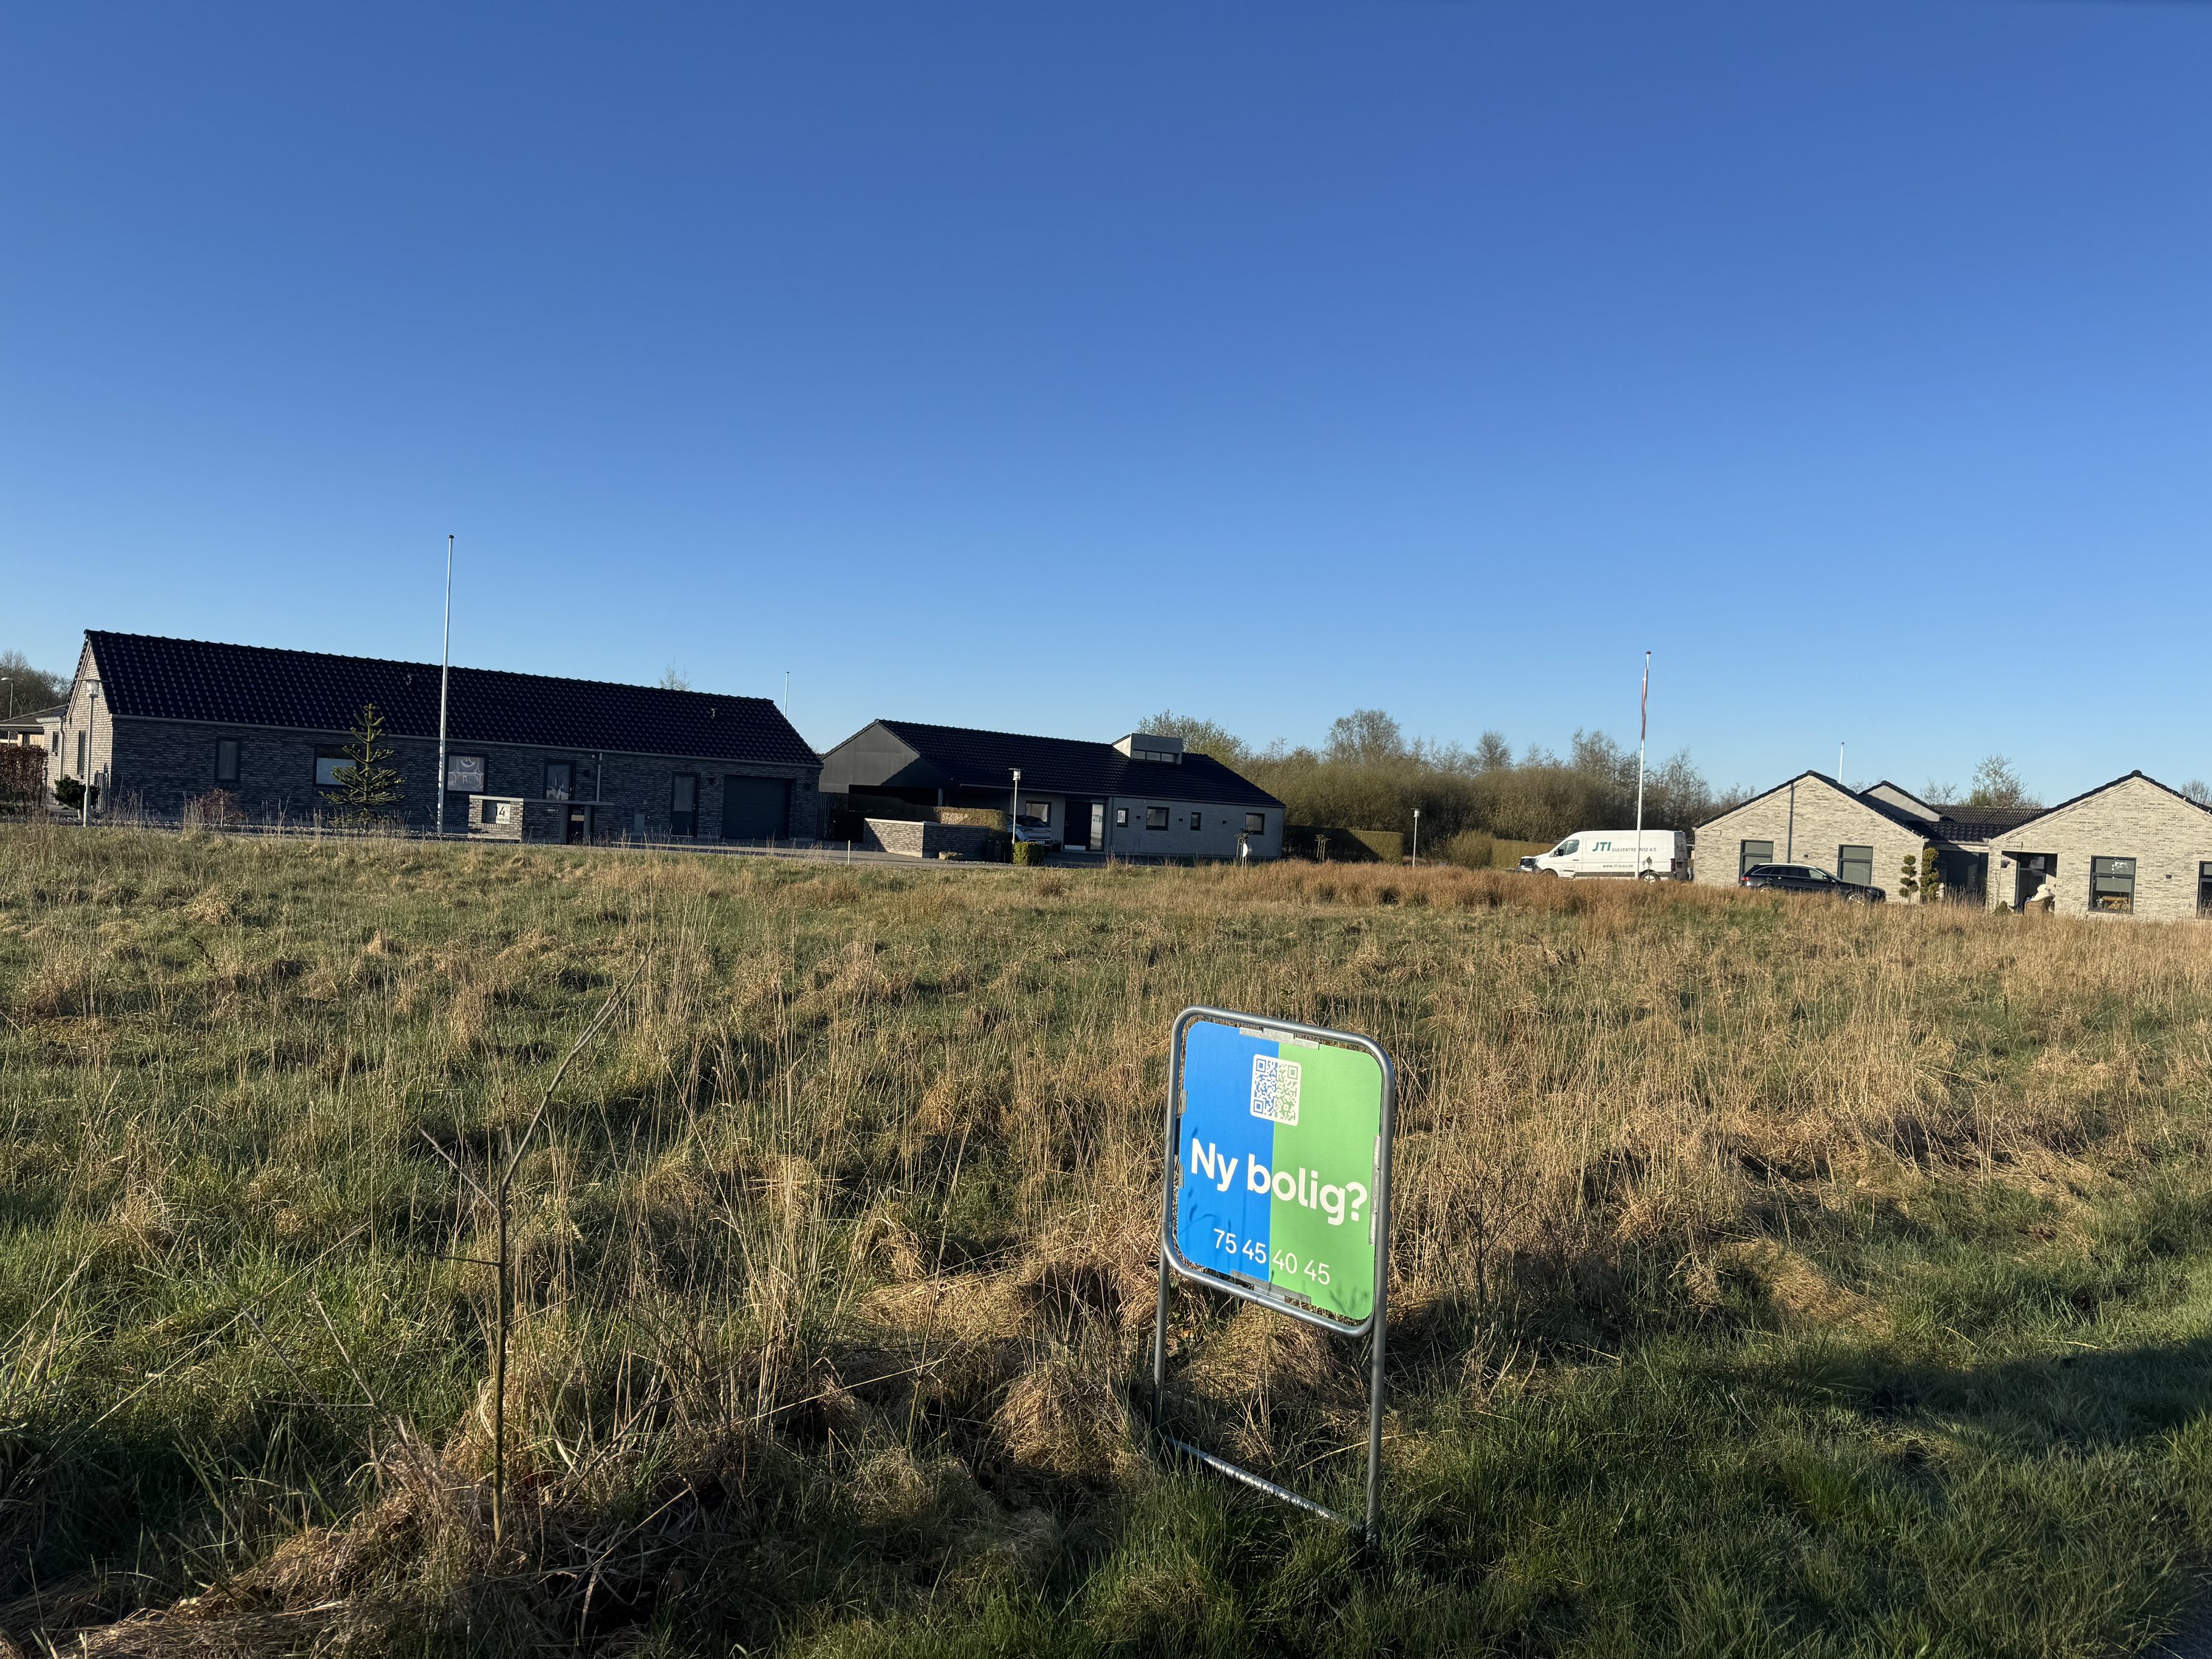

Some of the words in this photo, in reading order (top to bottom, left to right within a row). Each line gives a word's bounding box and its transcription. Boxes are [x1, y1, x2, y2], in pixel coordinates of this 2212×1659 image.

[1592, 841, 1612, 852] JTI
[1191, 1138, 1239, 1192] Ny
[1247, 1153, 1368, 1226] bolig?
[1213, 1228, 1237, 1254] 75
[1242, 1239, 1267, 1265] 45
[1272, 1249, 1298, 1275] 40
[1304, 1259, 1330, 1285] 45
